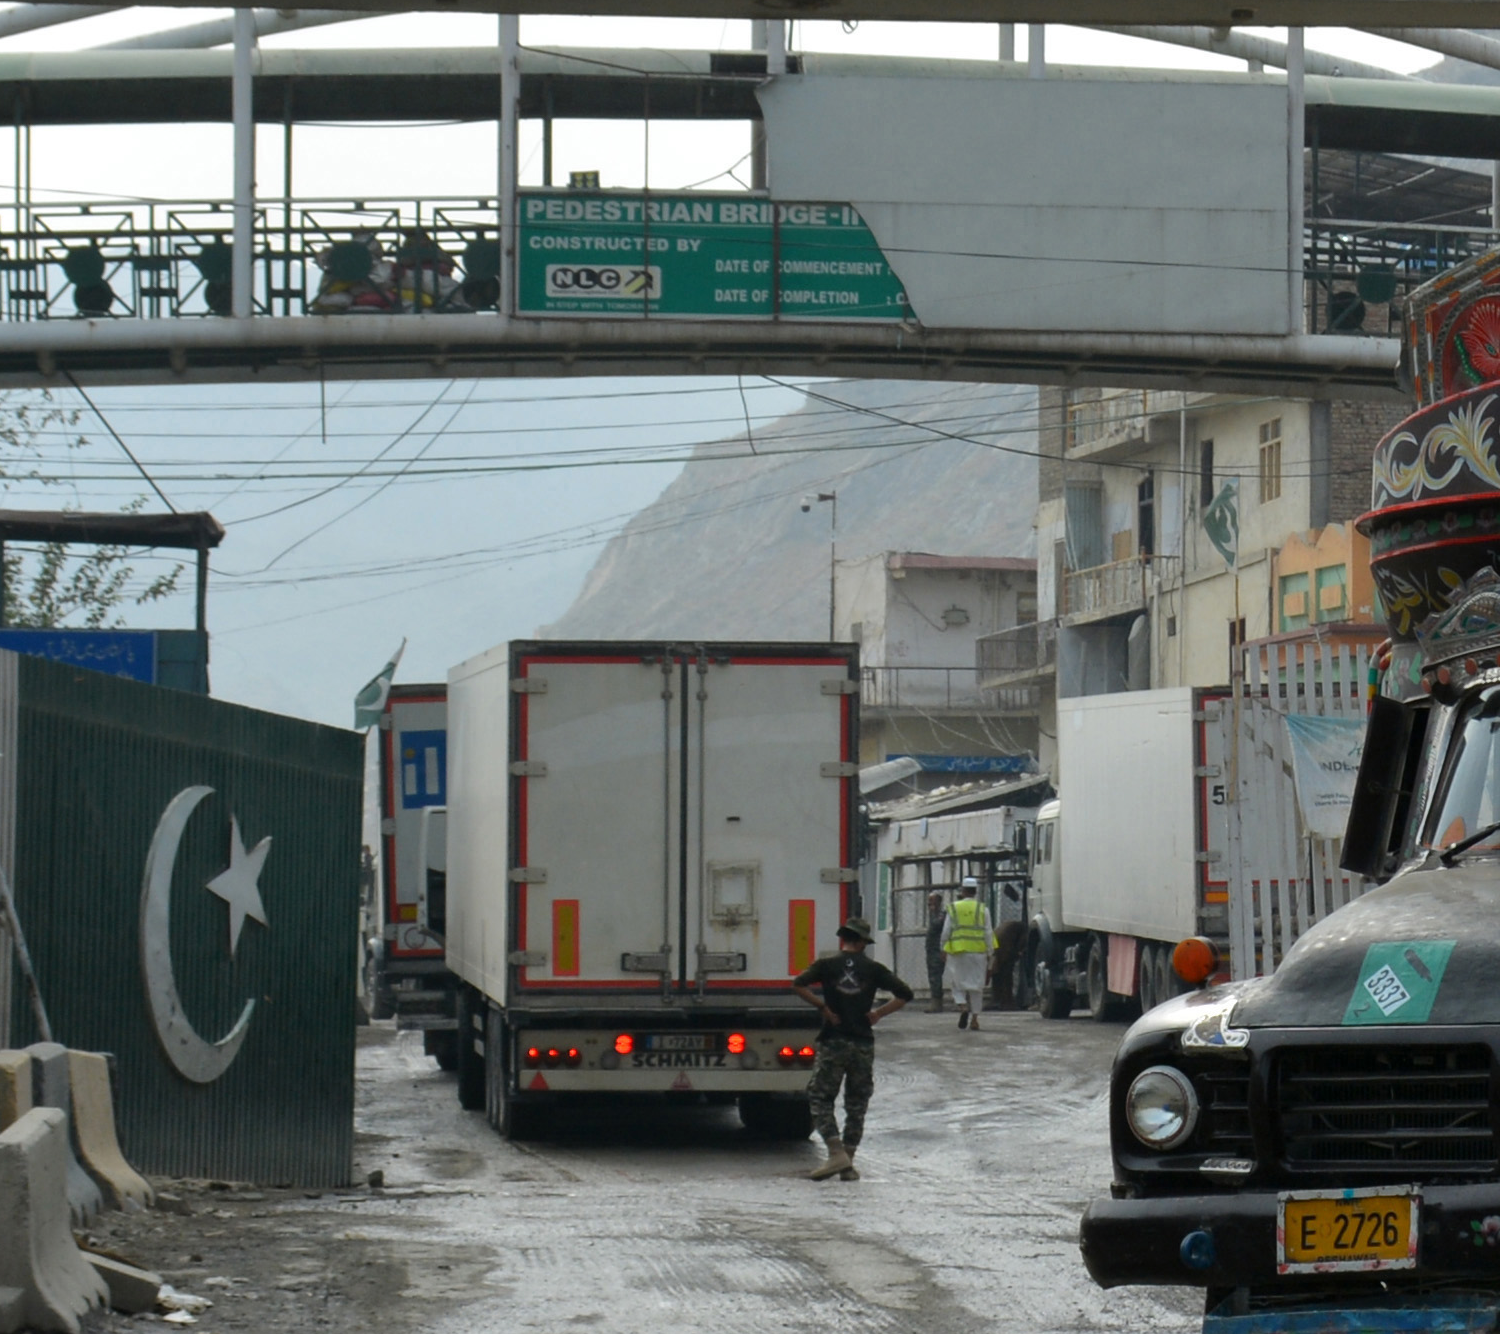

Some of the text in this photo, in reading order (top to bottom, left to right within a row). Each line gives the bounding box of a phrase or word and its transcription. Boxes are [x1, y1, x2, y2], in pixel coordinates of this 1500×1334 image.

[527, 200, 713, 223] PEDESTRIAN
[529, 236, 701, 252] CONSTRUCTED BY
[715, 259, 749, 273] DATE
[753, 260, 770, 273] OF
[555, 270, 619, 287] NLC
[715, 289, 748, 302] DATE
[751, 289, 769, 302] OF
[1367, 969, 1408, 1010] 3337
[632, 1053, 727, 1068] SCHMITZ
[1301, 1211, 1399, 1250] E 2726
